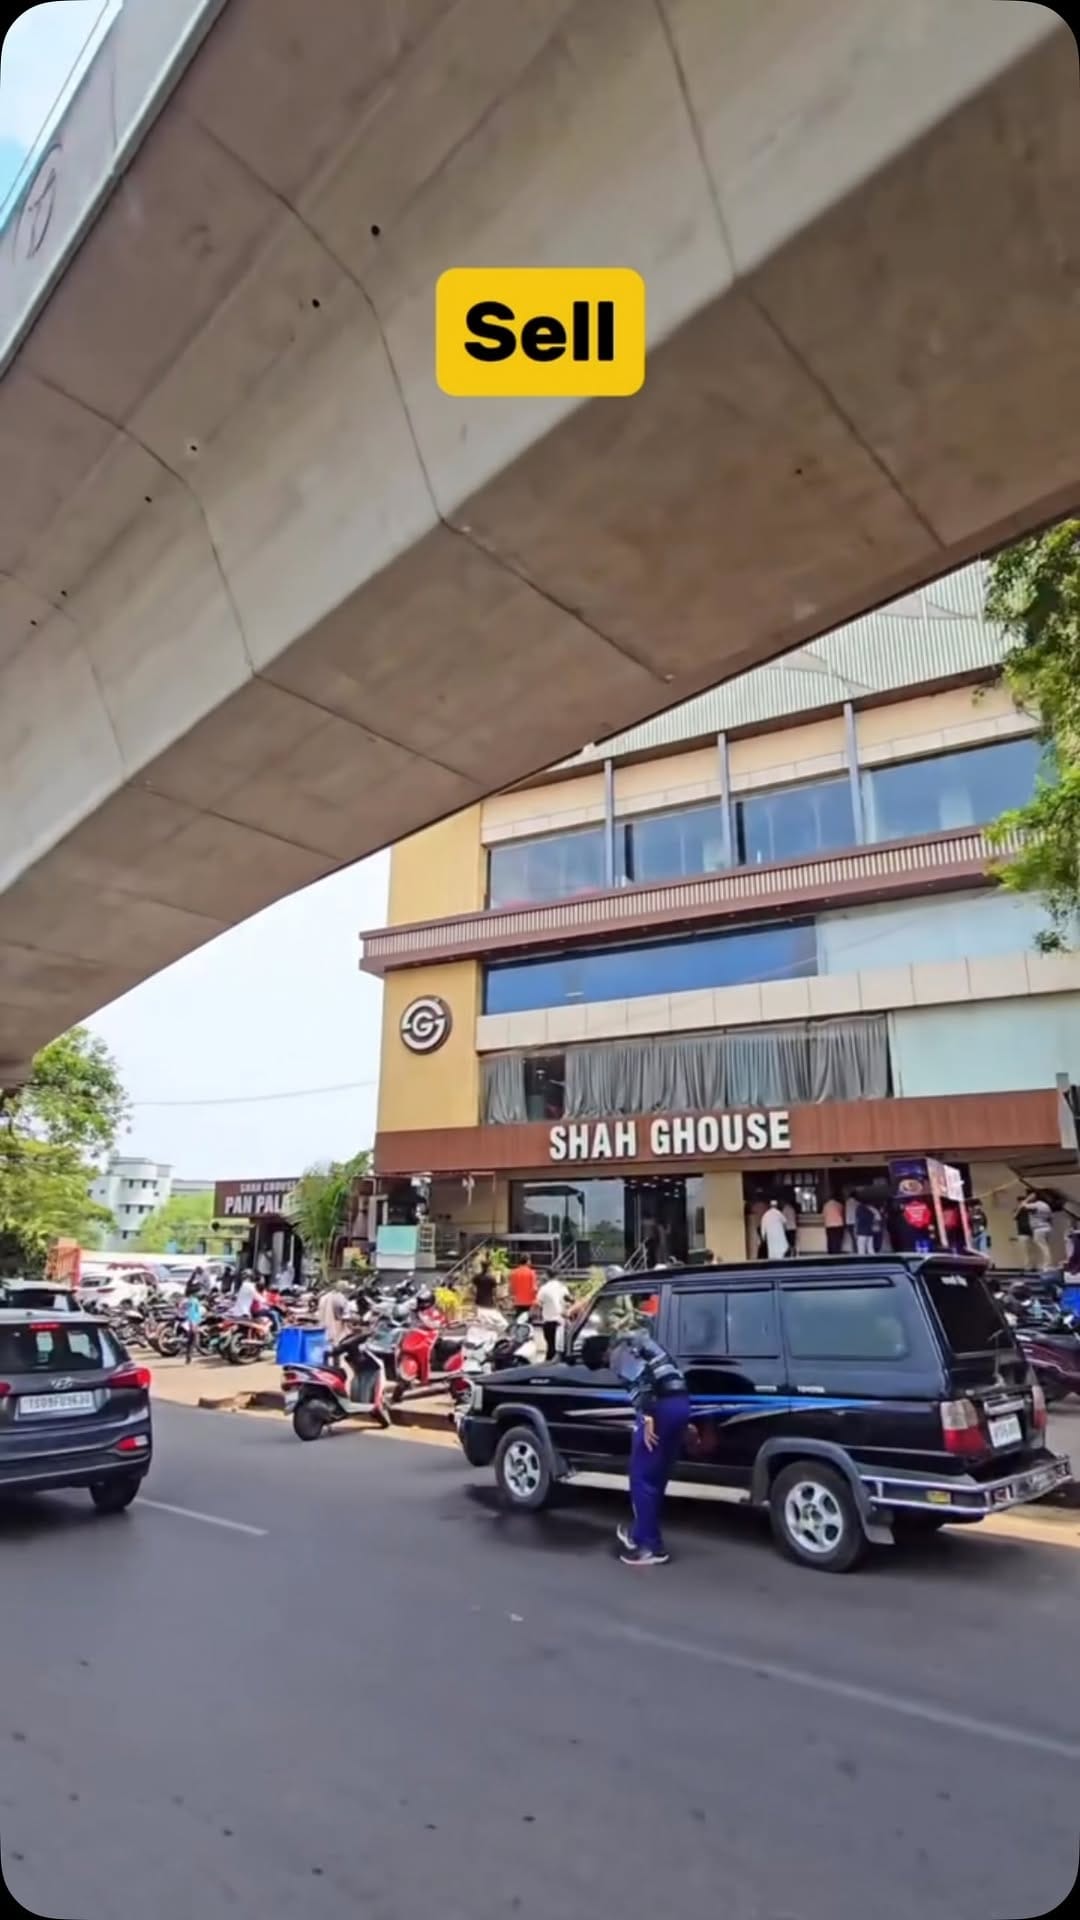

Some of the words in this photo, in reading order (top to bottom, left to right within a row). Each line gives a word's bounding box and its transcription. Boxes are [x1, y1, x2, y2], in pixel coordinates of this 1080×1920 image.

[549, 1120, 637, 1160] SHAH
[650, 1111, 792, 1155] GHOUSE
[224, 1195, 251, 1214] PAN
